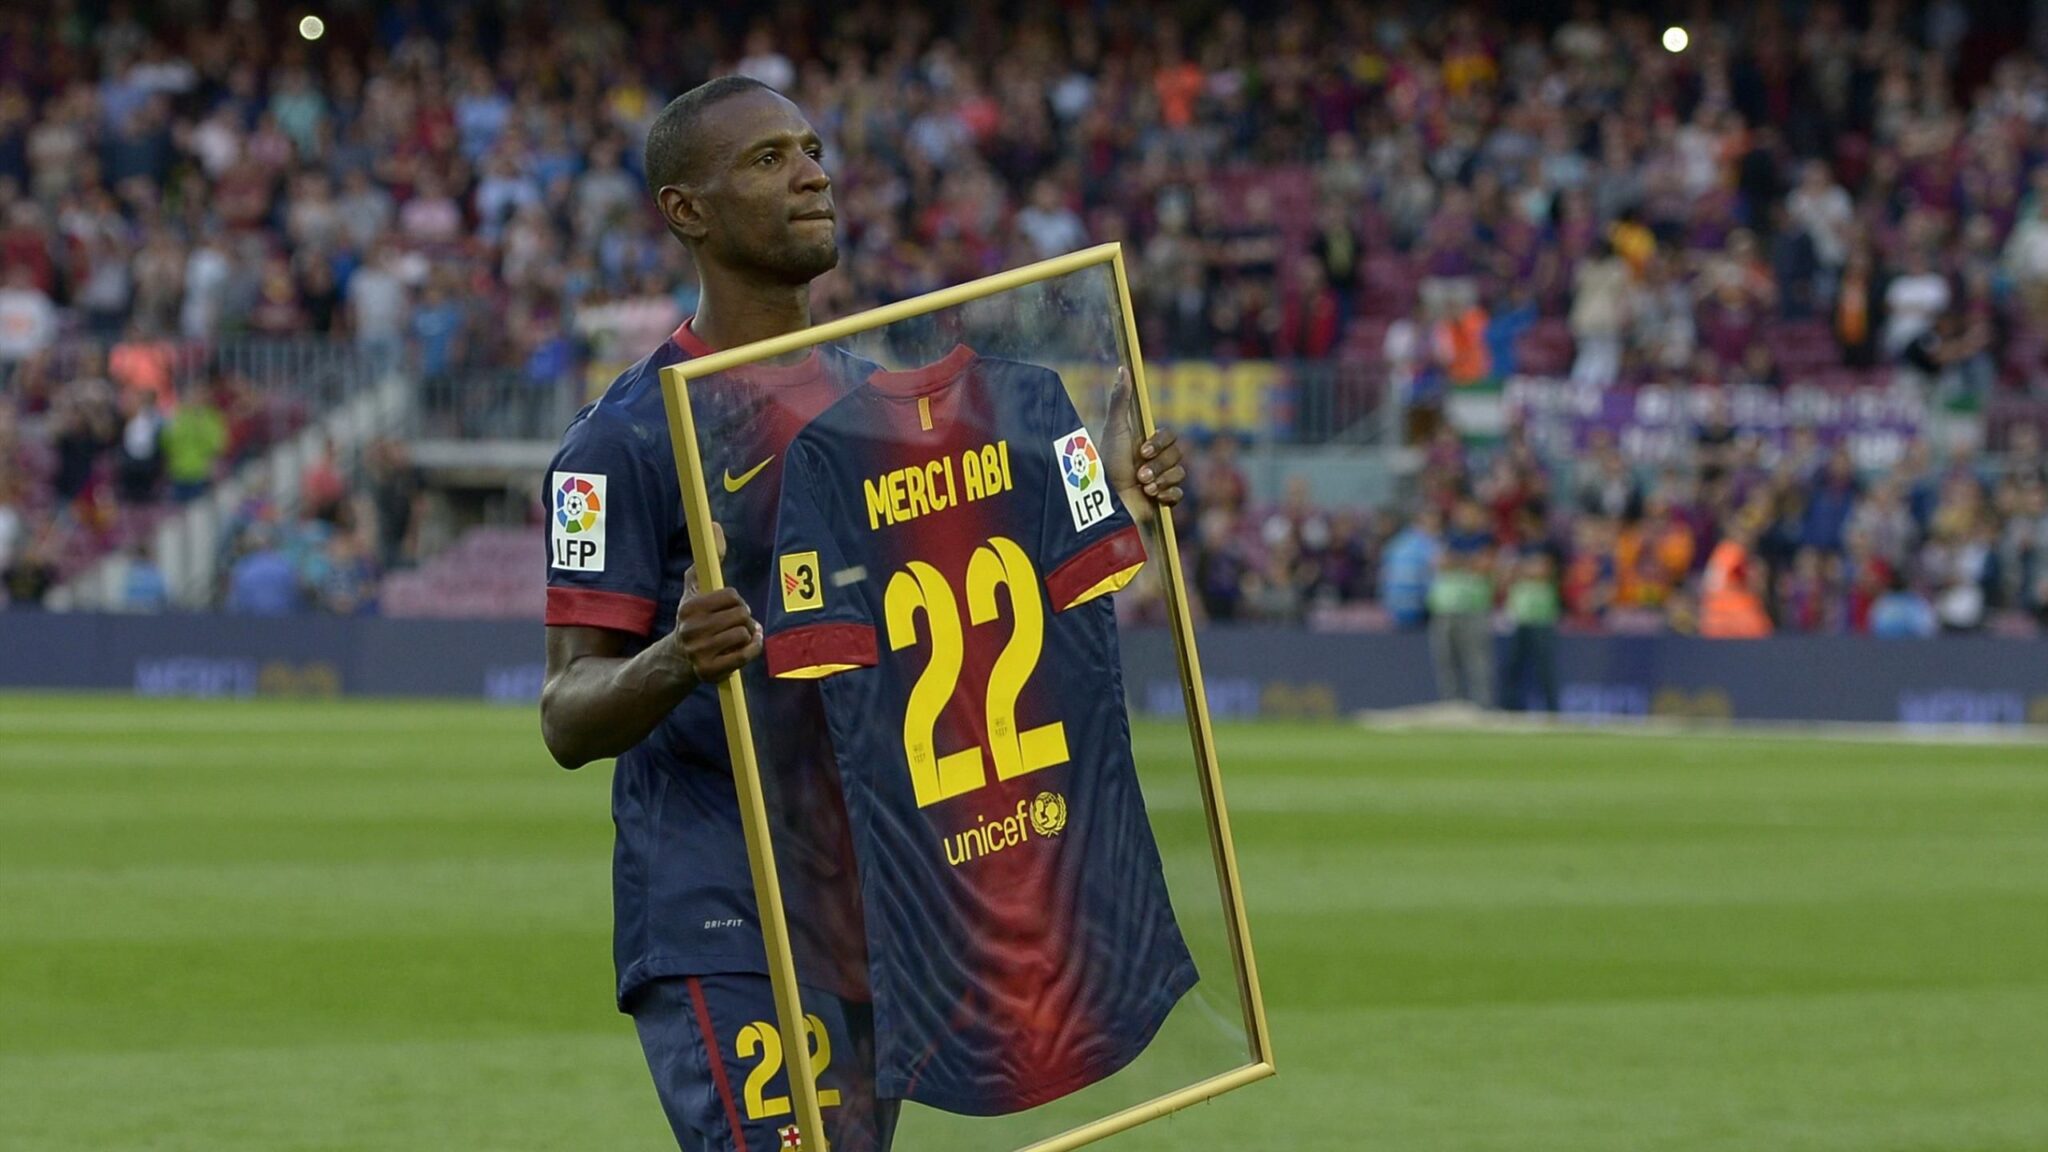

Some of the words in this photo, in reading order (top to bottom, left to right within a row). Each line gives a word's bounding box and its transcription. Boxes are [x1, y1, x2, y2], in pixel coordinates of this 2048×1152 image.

[864, 456, 958, 530] MERCI
[962, 440, 1013, 502] ABI
[1075, 489, 1104, 526] LFP
[556, 538, 597, 568] LFP
[796, 563, 815, 600] 3
[884, 536, 1070, 809] 22
[943, 799, 1028, 866] unicef
[703, 919, 743, 929] DRI-FIT
[735, 1013, 841, 1120] 22
